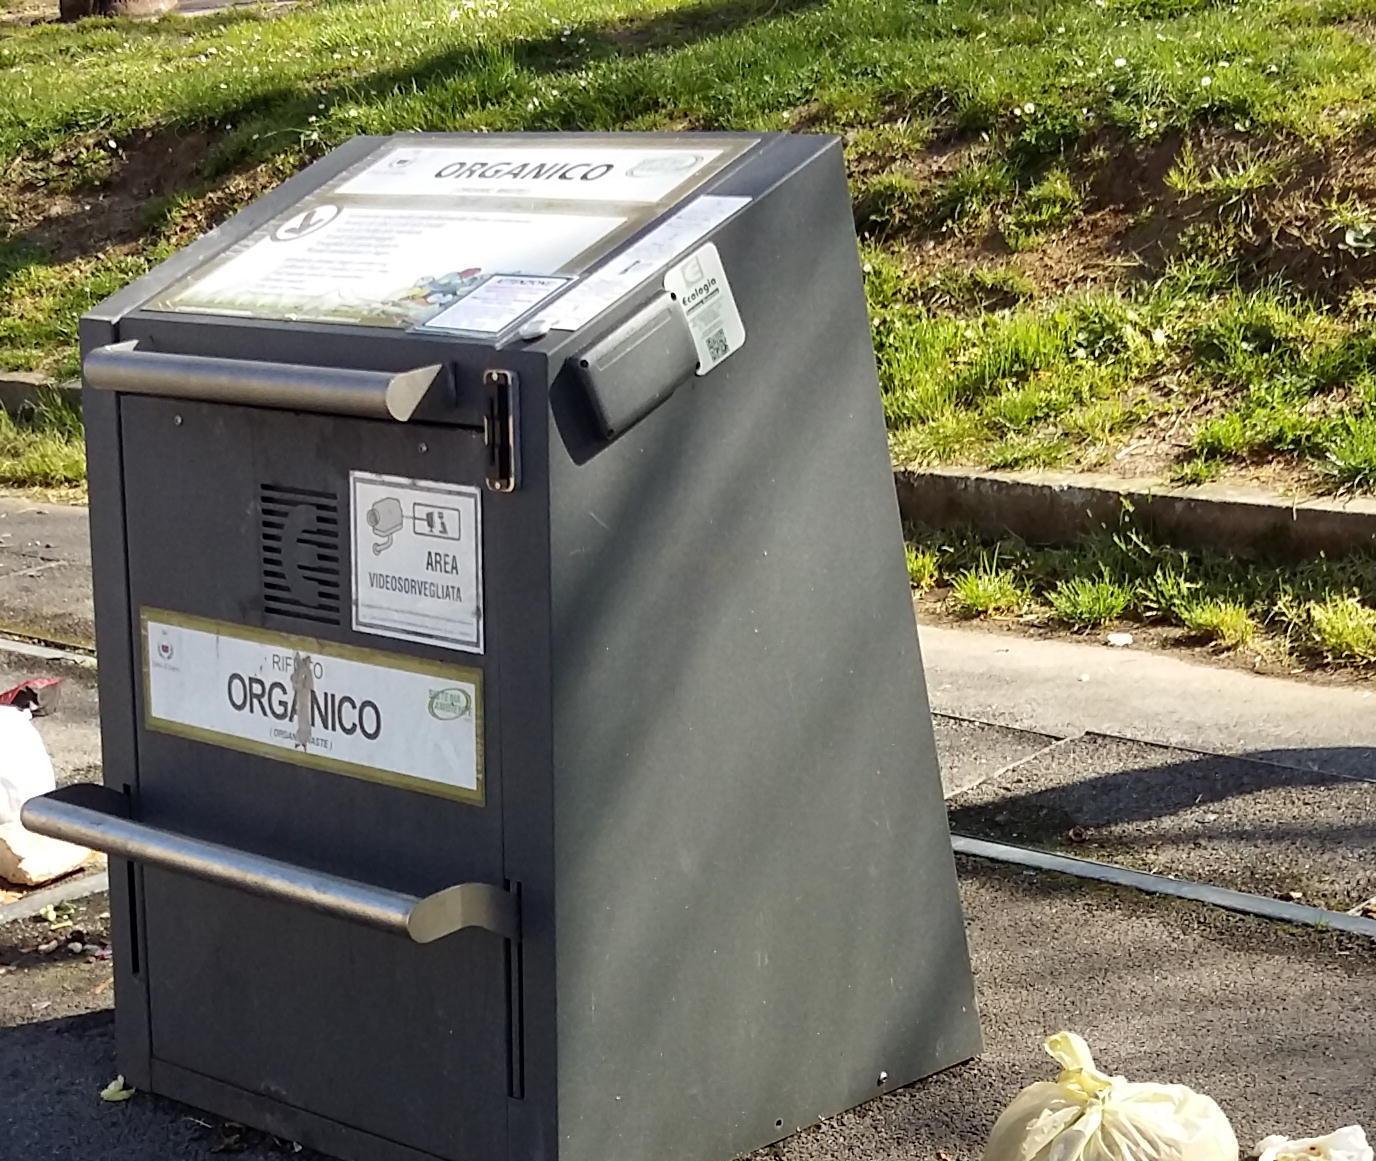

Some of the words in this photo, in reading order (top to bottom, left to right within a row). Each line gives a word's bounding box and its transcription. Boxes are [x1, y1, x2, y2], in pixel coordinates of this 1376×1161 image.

[435, 161, 614, 181] ORGANICO
[682, 277, 717, 306] Ecologia
[425, 550, 459, 576] AREA
[368, 571, 462, 603] VIDEOSORVEGLIATA
